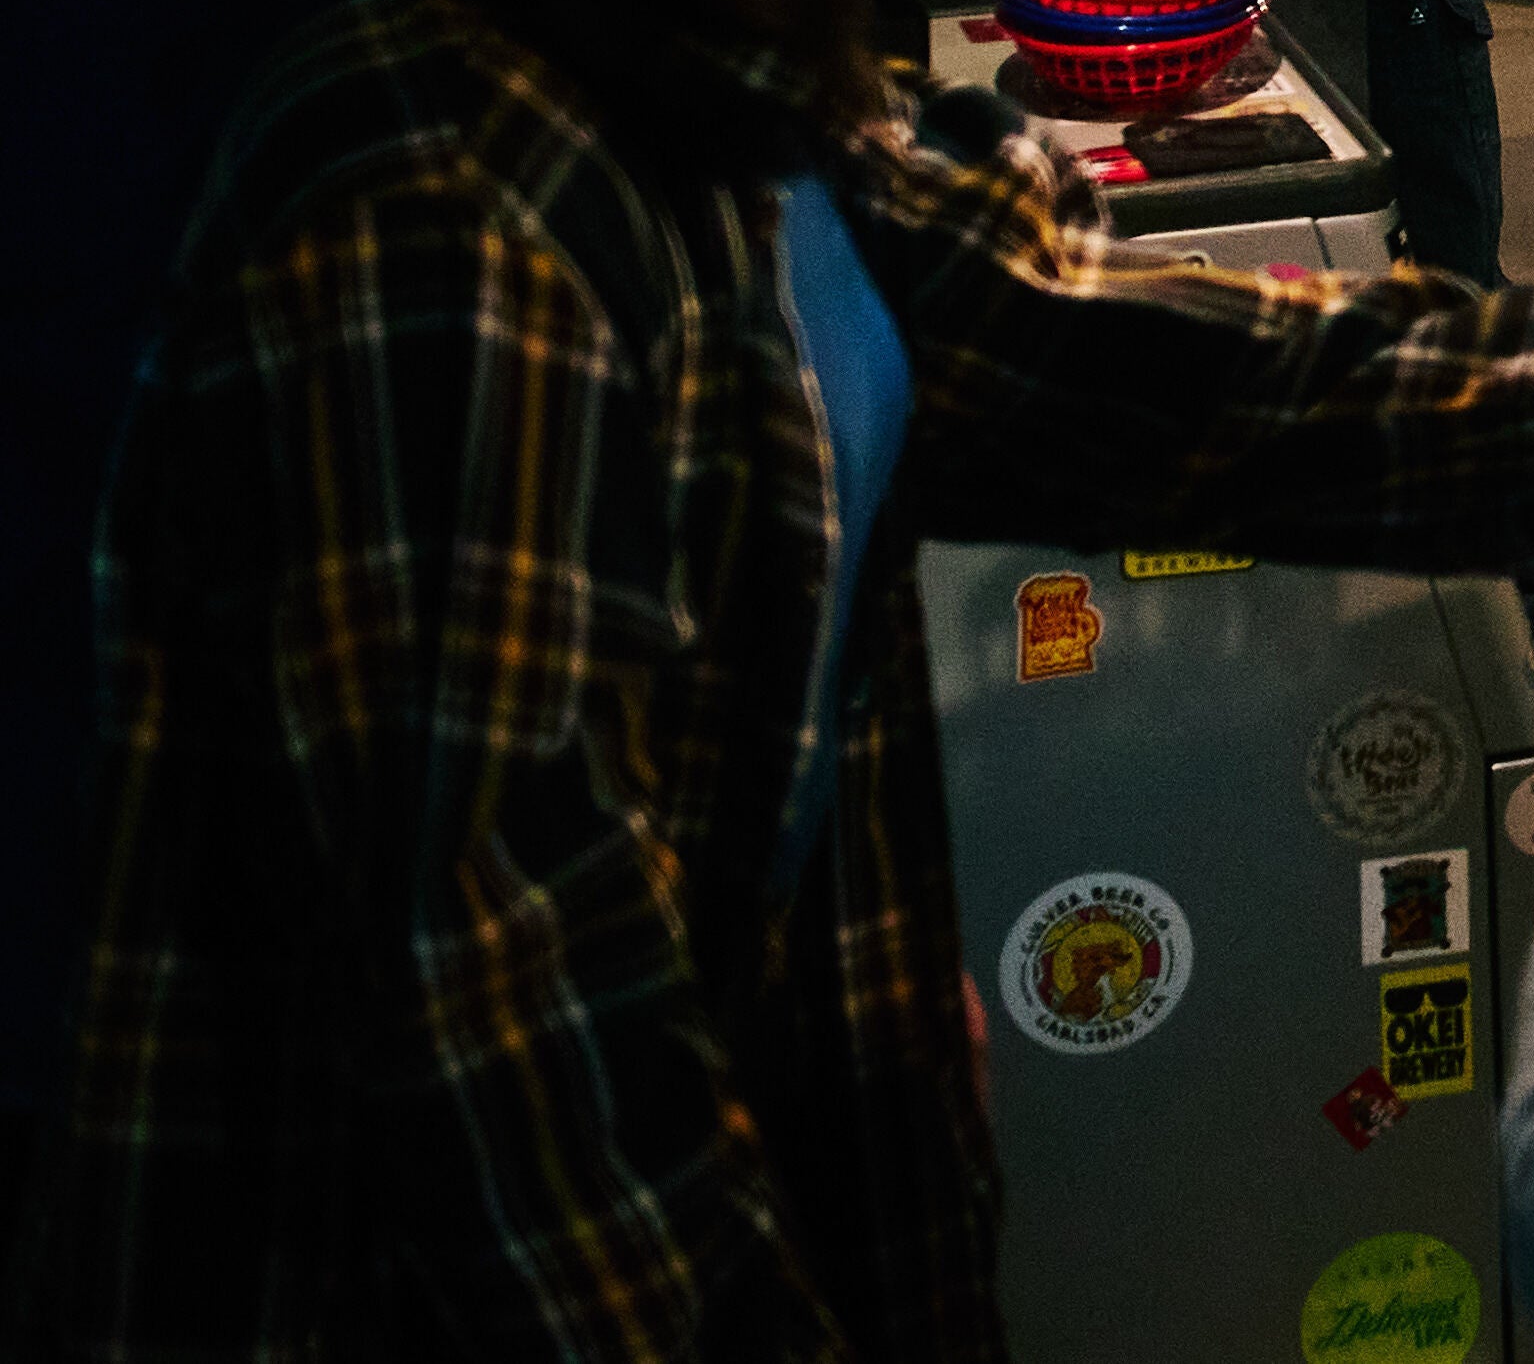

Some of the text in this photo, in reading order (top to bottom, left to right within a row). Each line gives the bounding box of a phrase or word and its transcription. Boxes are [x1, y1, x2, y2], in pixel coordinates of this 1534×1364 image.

[1091, 887, 1146, 906] BEER
[1036, 1015, 1135, 1044] CARLSBAD
[1387, 1007, 1466, 1054] OKEI
